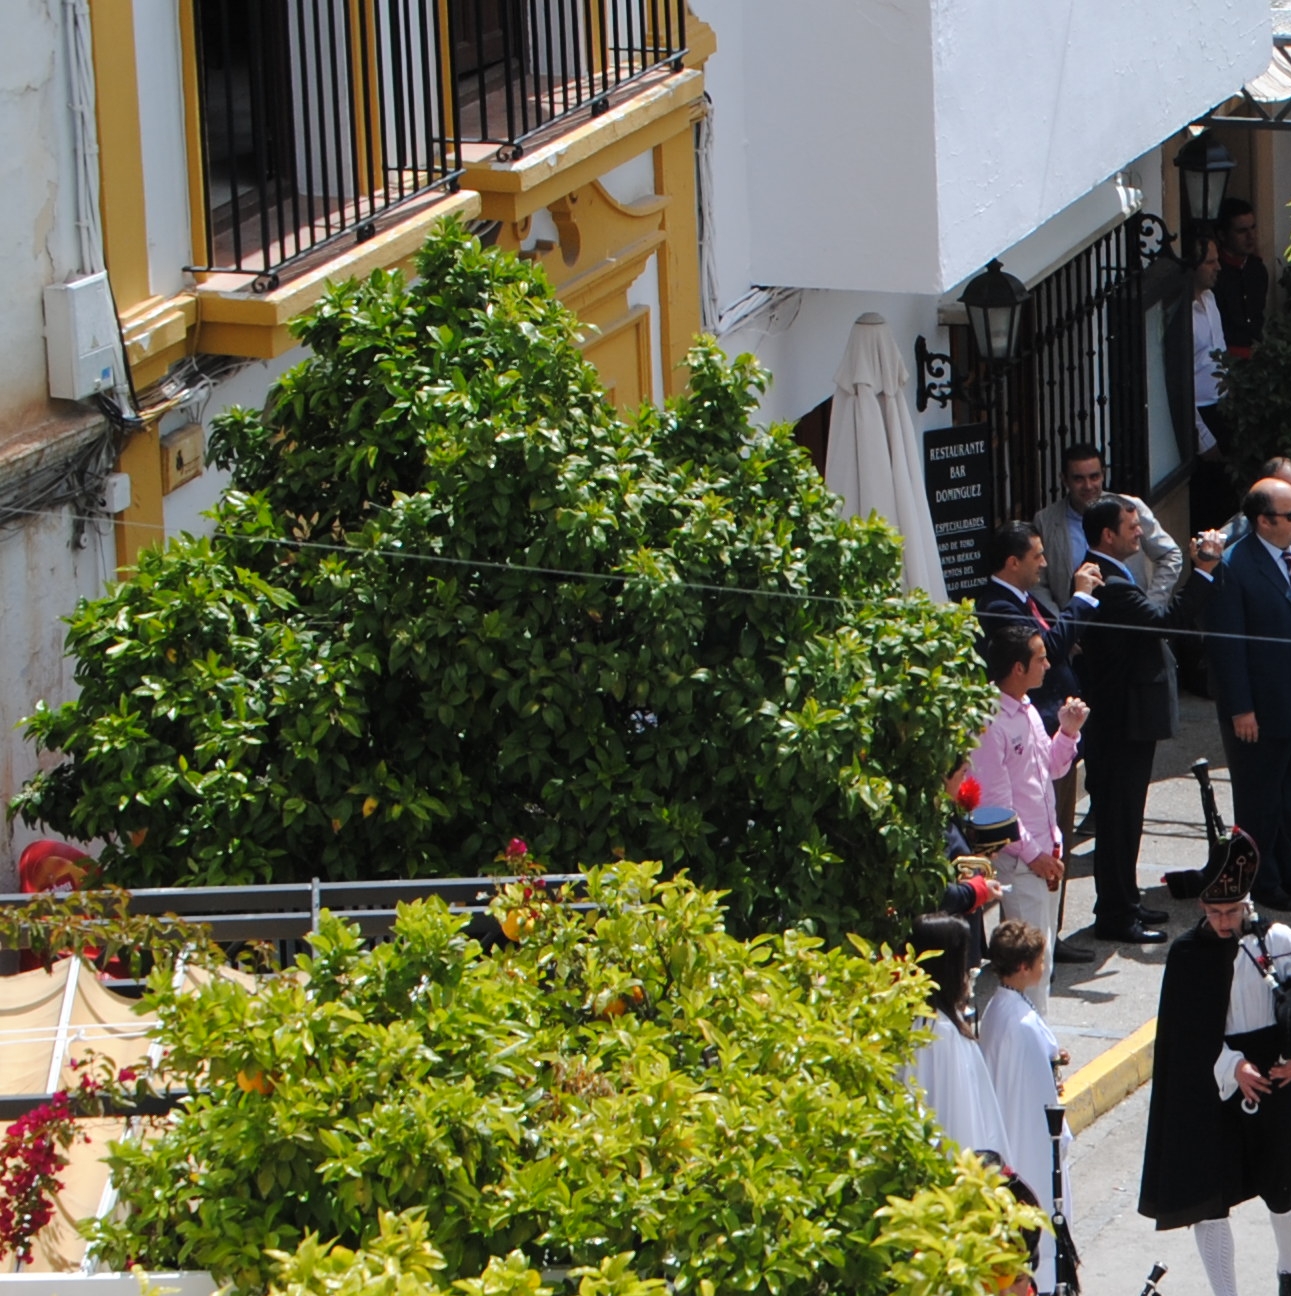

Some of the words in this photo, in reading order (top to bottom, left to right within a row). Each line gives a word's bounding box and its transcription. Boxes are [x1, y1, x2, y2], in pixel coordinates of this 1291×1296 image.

[930, 440, 985, 461] RESTAURANTE
[950, 464, 966, 479] BAR
[935, 483, 982, 503] DOMINGUEZ
[935, 516, 985, 534] ESPECIALIDADES
